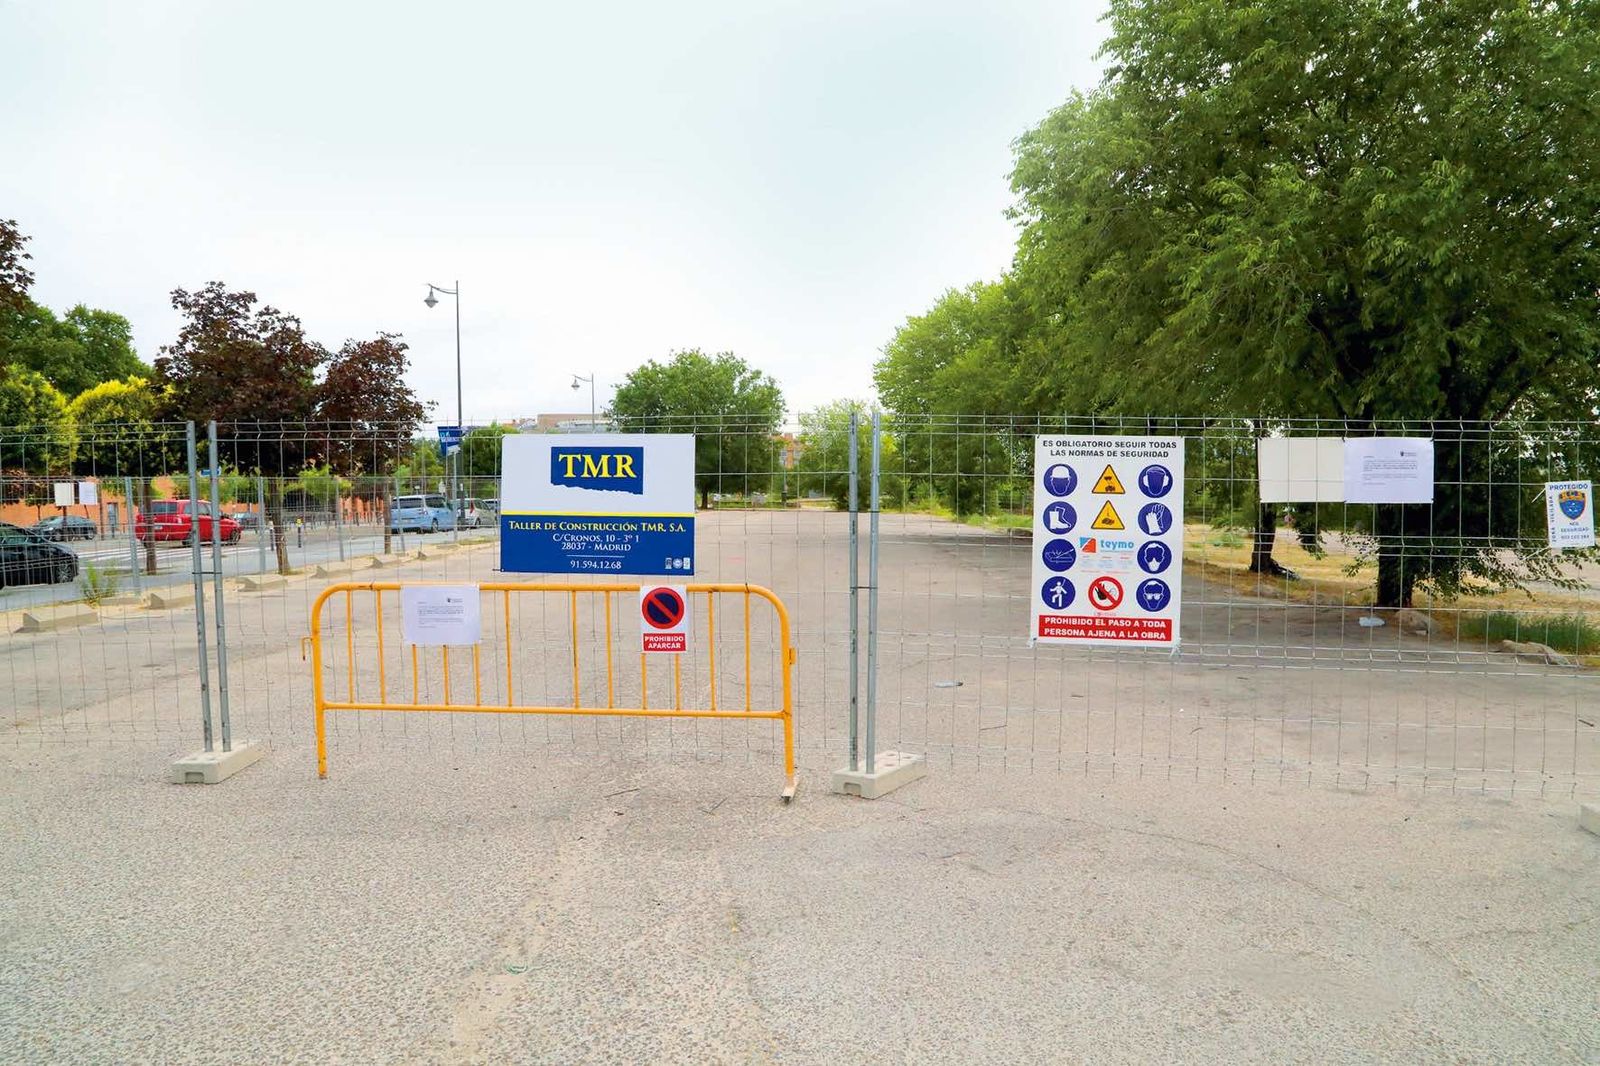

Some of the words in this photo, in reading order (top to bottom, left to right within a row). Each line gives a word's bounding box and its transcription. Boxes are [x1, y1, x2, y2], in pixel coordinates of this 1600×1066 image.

[1055, 440, 1112, 448] OBLIGATORIO
[1149, 441, 1177, 449] TODAS
[1050, 449, 1066, 457] LAS
[1119, 450, 1169, 458] SEGURIDAD
[558, 453, 637, 478] TMR
[508, 520, 542, 531] TALLER
[544, 522, 557, 531] DE
[559, 521, 638, 532] CONSTRUCCIÓN
[669, 522, 687, 532] S.A.
[605, 534, 615, 542] 10
[561, 542, 586, 550] 28037
[594, 543, 632, 551] MADRID
[1100, 540, 1135, 550] teymo
[1045, 617, 1093, 626] PROHIBIDO
[1108, 619, 1132, 627] PASO
[1142, 620, 1166, 628] TODA
[1044, 628, 1085, 637] PERSONA
[1118, 630, 1126, 638] A
[1141, 631, 1166, 639] OBRA
